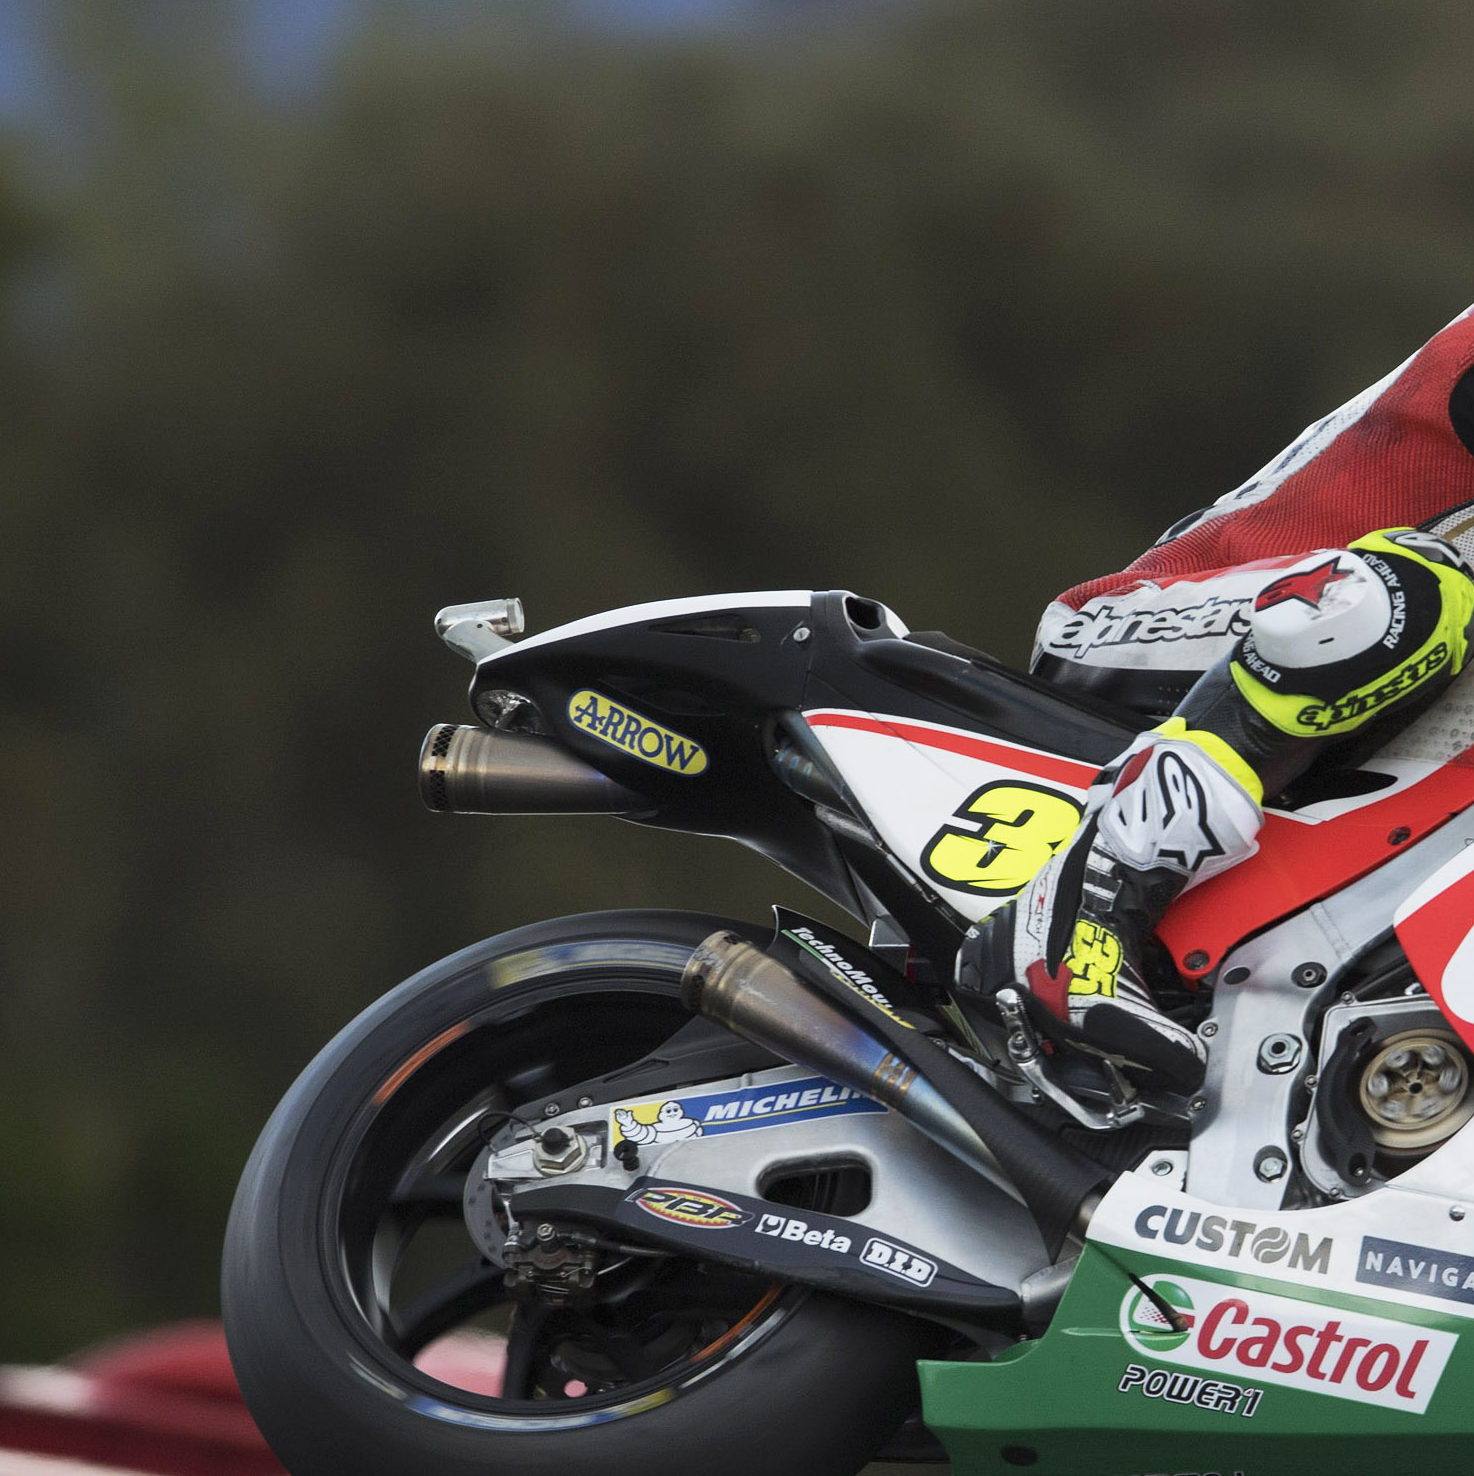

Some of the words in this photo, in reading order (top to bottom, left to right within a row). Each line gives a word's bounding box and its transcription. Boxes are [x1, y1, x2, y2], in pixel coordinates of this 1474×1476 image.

[1363, 553, 1401, 588] AHEAD
[1383, 591, 1406, 649] RACING
[1243, 652, 1281, 684] AHEAD
[574, 695, 701, 772] ARROW
[920, 779, 1085, 897] 3
[782, 1219, 853, 1254] Beta
[1135, 1204, 1334, 1275] CUSTOM
[1197, 1298, 1430, 1400] Castrol
[1118, 1363, 1265, 1418] POWER1
